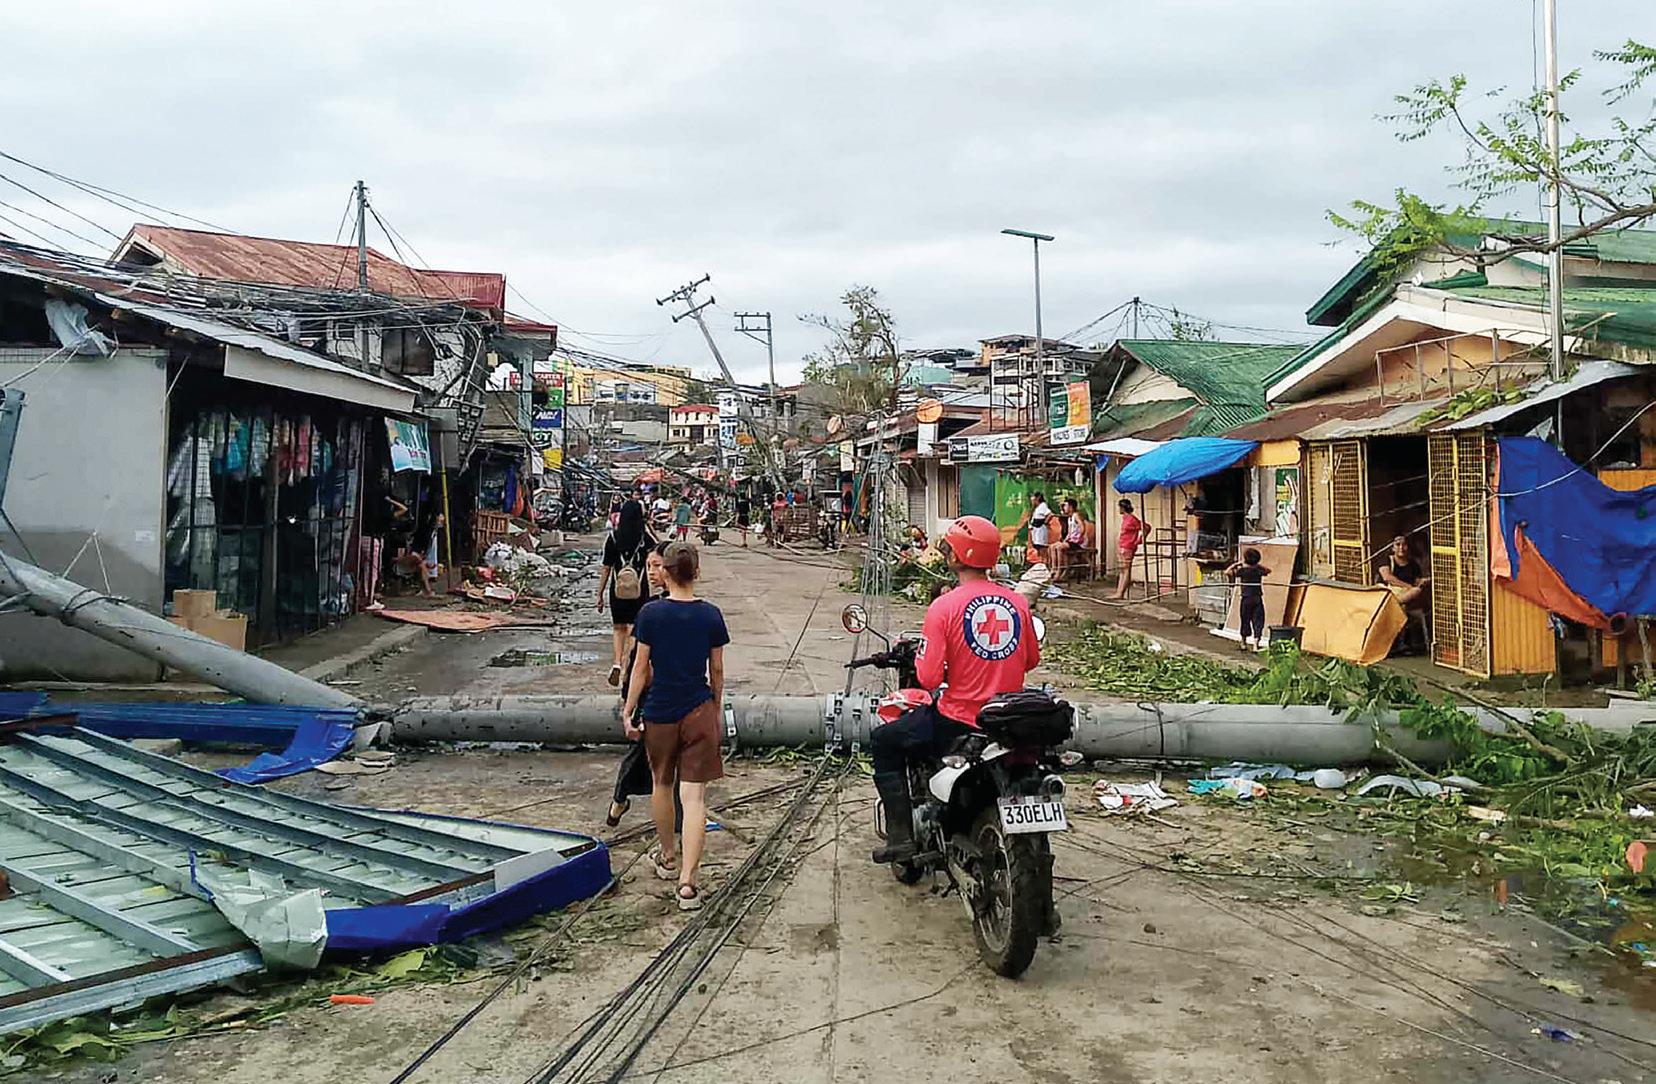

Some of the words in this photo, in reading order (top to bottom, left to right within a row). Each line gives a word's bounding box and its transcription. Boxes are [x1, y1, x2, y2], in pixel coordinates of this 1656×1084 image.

[965, 596, 1016, 619] PHILIPPINE
[991, 638, 1018, 659] CROSS
[1004, 803, 1062, 825] 330ELH
